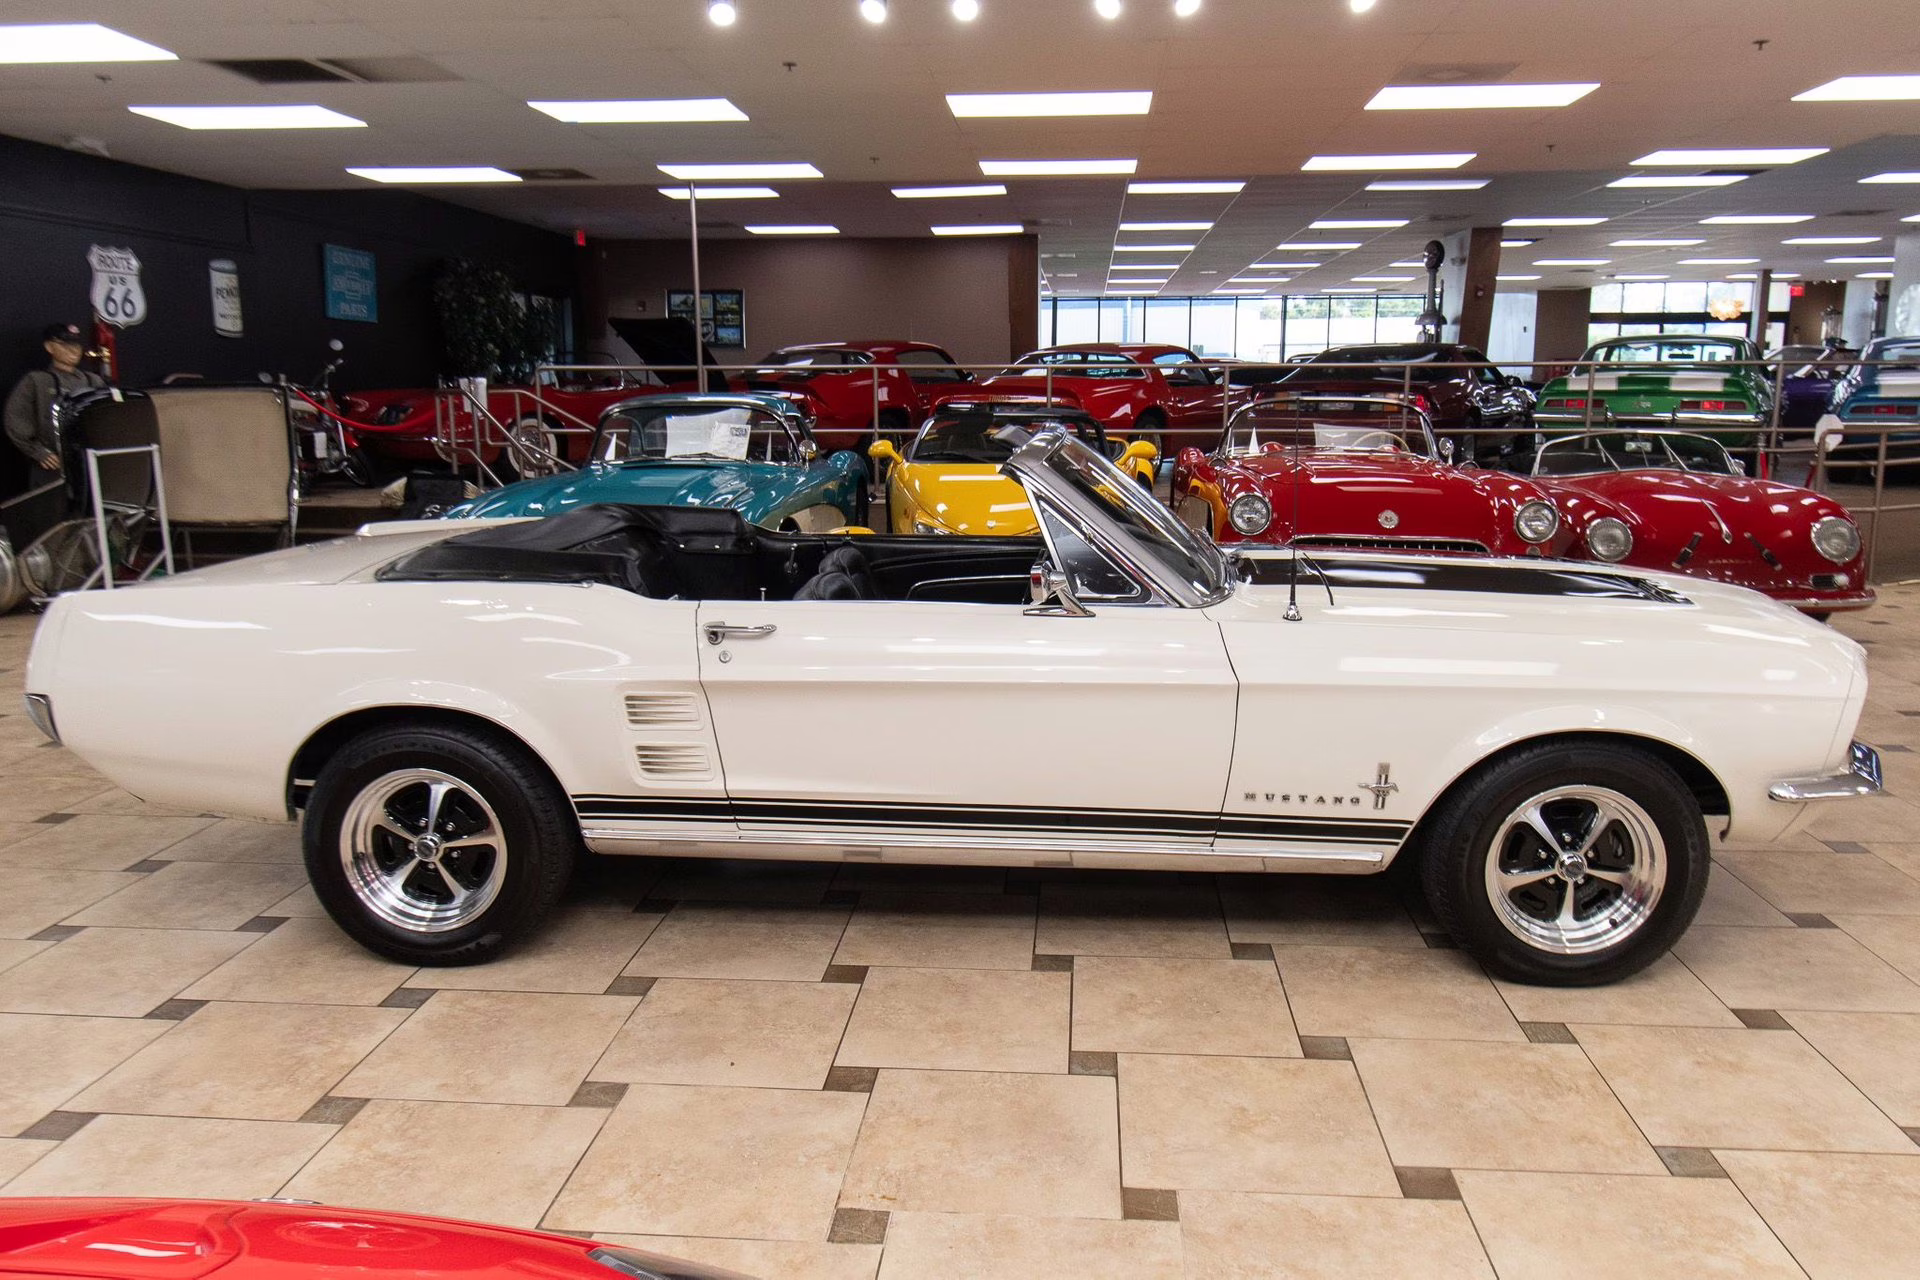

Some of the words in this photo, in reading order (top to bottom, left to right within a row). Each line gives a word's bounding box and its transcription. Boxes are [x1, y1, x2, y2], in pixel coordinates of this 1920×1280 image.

[97, 253, 134, 271] ROUTE
[108, 275, 127, 286] US
[105, 287, 136, 318] 66
[1244, 792, 1360, 805] MUSTANG
